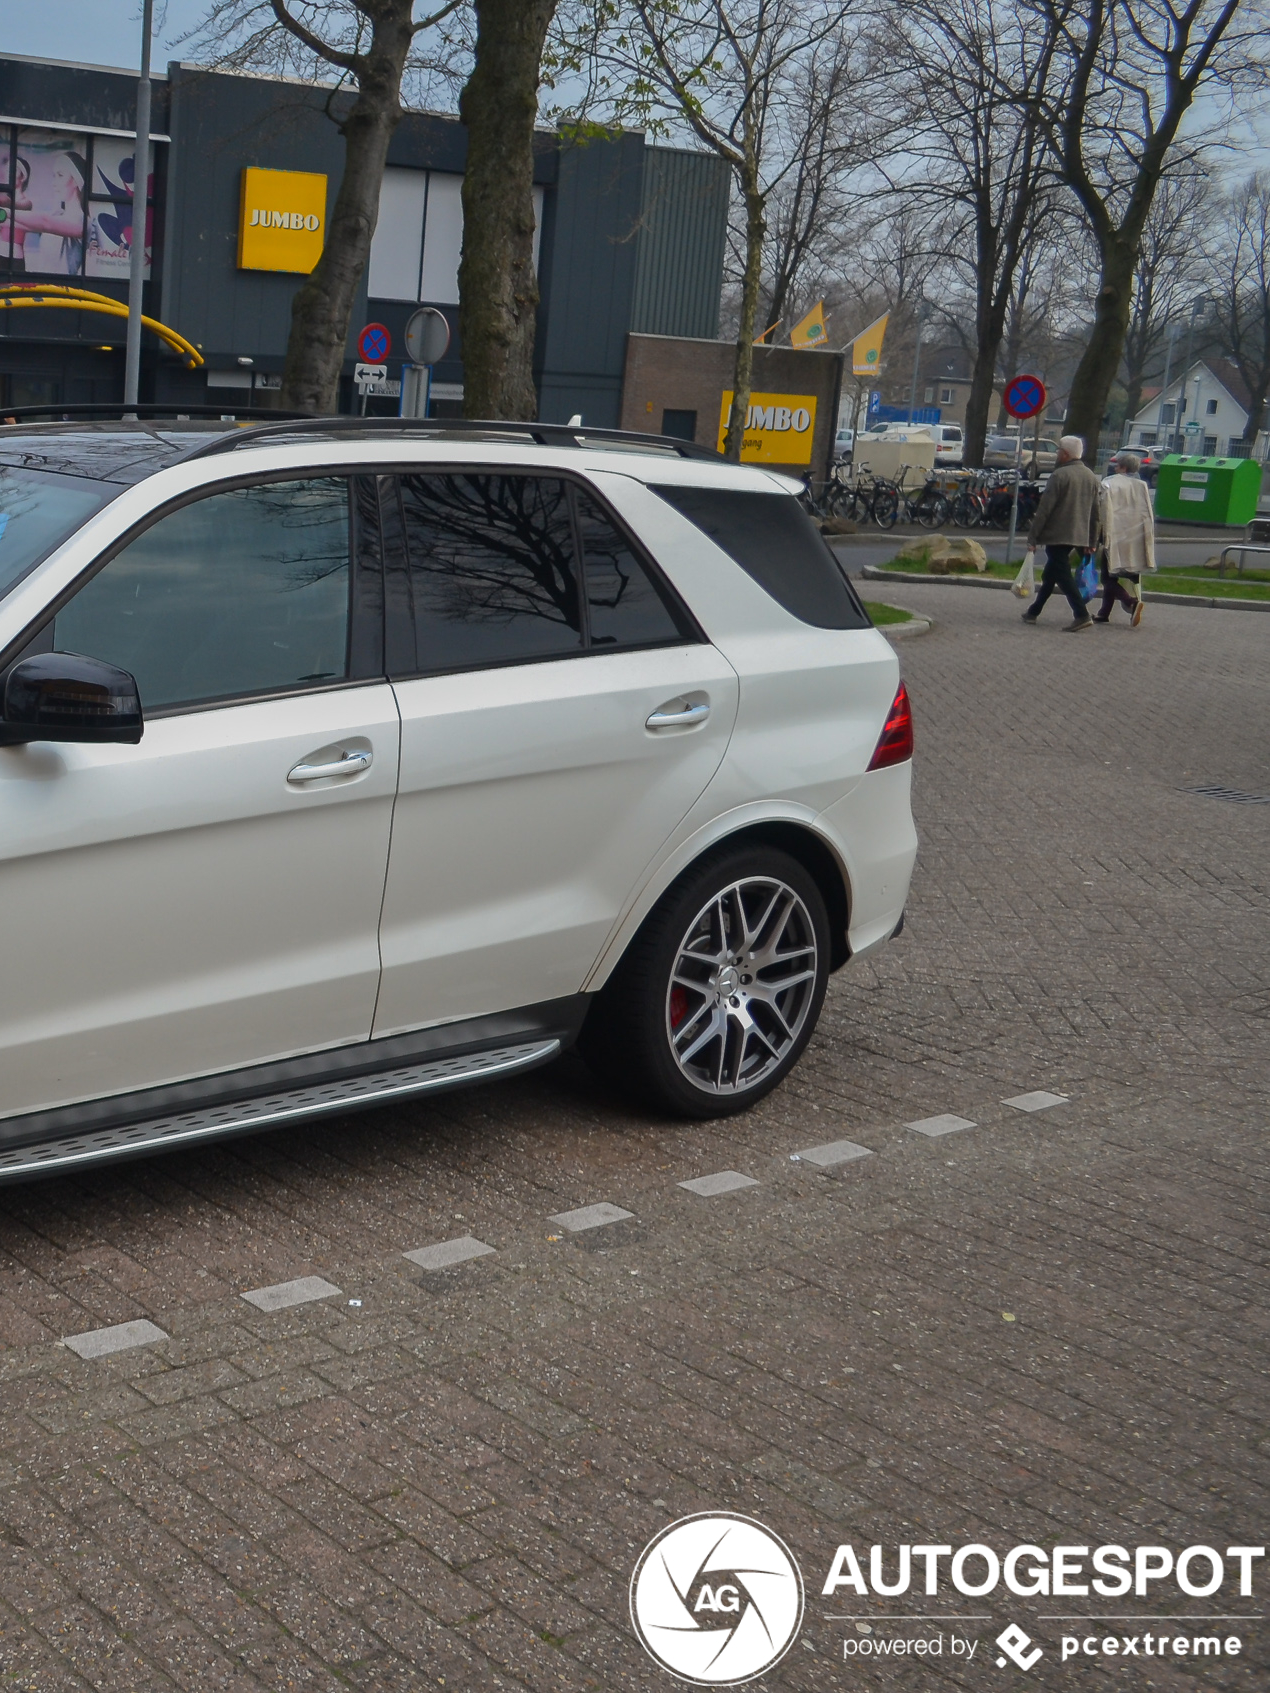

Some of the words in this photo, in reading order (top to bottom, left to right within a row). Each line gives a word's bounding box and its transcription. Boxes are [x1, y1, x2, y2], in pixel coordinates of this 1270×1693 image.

[249, 208, 320, 232] JUMBO
[88, 241, 127, 259] Female
[742, 439, 763, 450] gang
